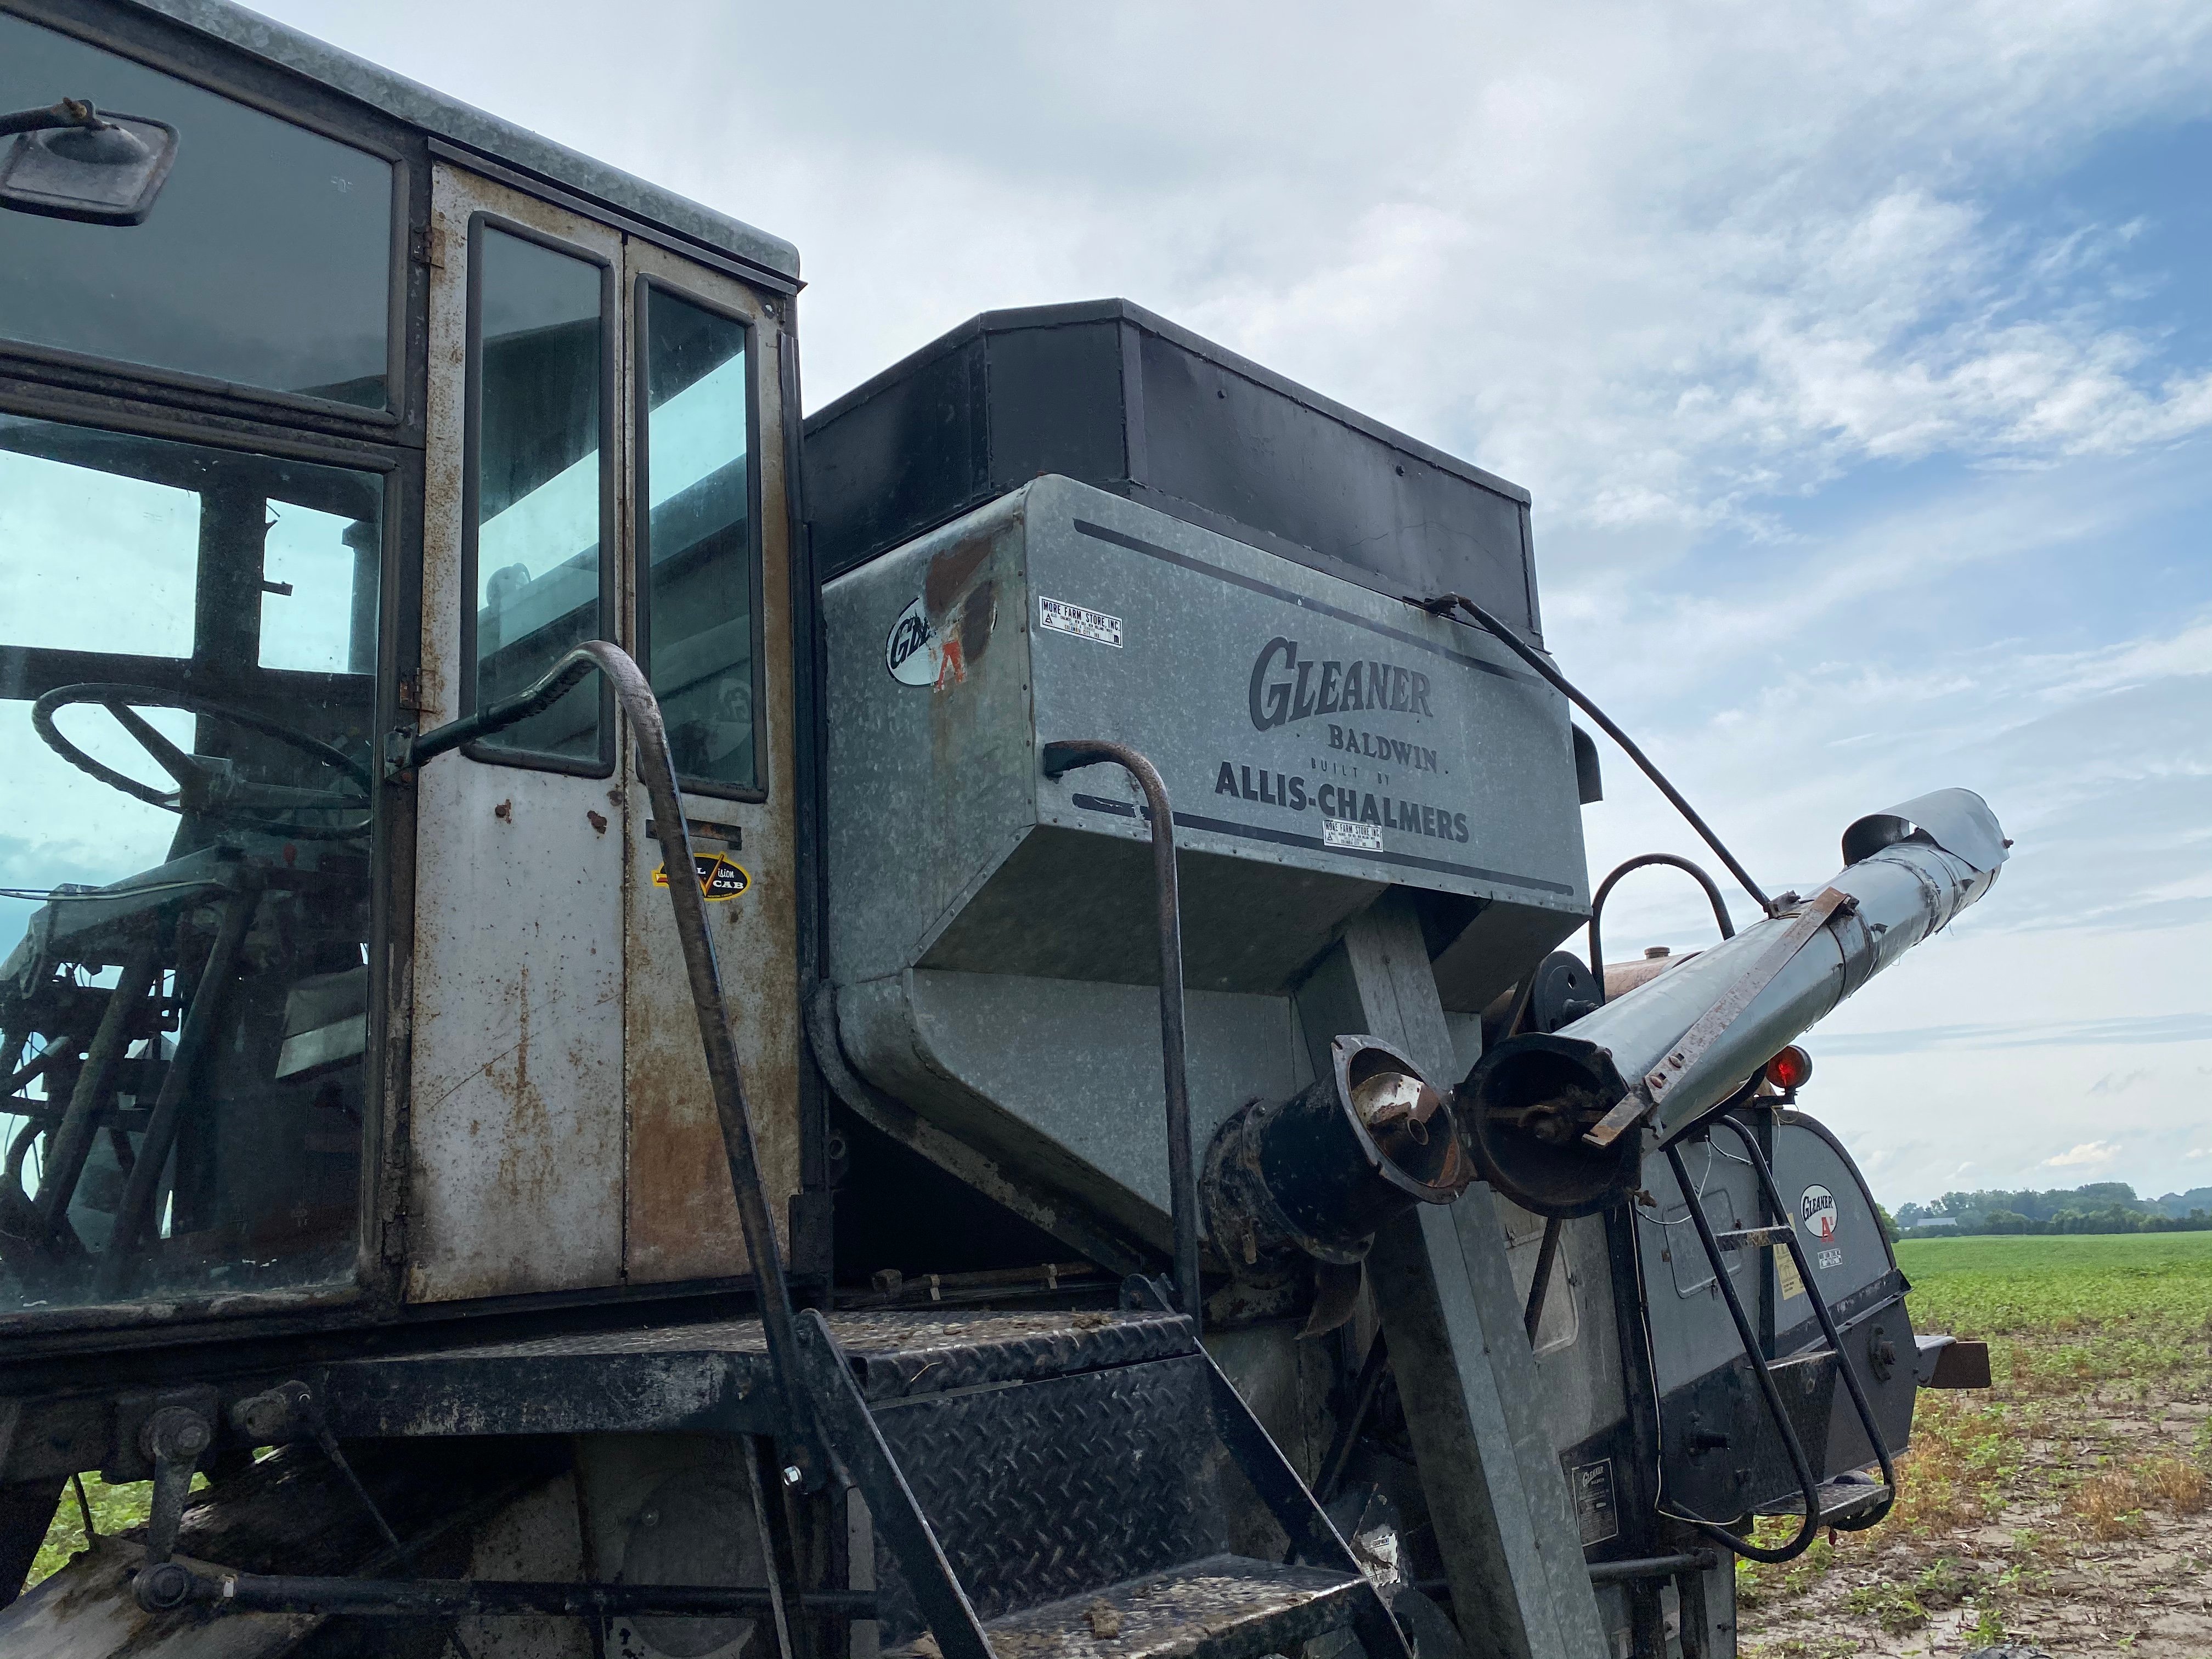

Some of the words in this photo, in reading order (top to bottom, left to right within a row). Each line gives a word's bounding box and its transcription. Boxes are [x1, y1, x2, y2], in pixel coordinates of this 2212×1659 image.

[1043, 600, 1061, 615] MORE
[1064, 607, 1082, 620] FARM
[1108, 619, 1120, 631] INC.
[1249, 635, 1434, 732] GLEANER
[1328, 724, 1437, 774] BALDWIN
[1311, 757, 1358, 778] BUILT
[1378, 772, 1389, 786] BY
[1215, 761, 1469, 843] ALLIS-CHALMERS
[1340, 823, 1353, 833] FARM
[713, 880, 744, 889] CAB
[1802, 1195, 1834, 1222] GLEANER
